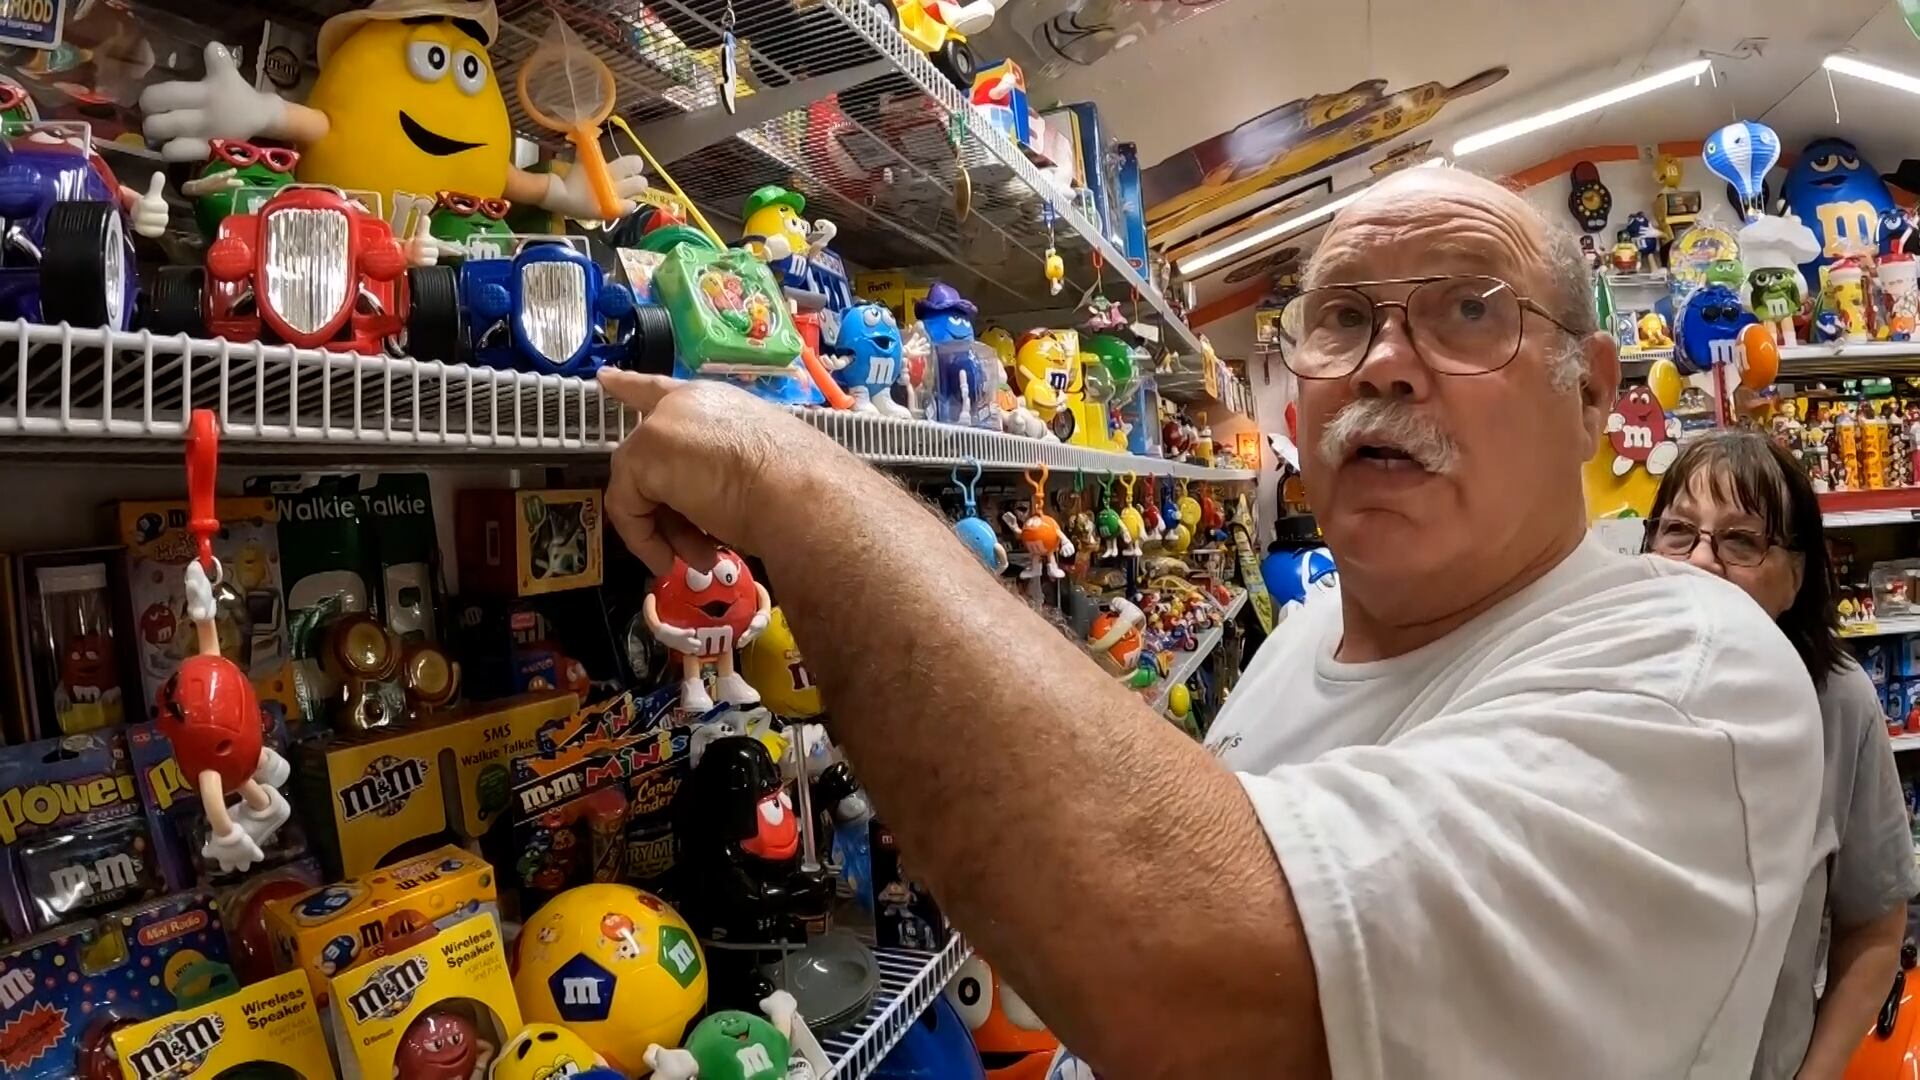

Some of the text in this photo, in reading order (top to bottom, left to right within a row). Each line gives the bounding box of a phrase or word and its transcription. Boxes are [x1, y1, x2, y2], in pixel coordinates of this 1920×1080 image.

[1815, 199, 1880, 258] m
[1765, 298, 1790, 316] m
[865, 355, 895, 385] m
[1623, 424, 1653, 449] m
[360, 493, 426, 517] Talkie
[697, 624, 734, 657] m
[483, 723, 512, 743] SMS
[460, 738, 536, 767] Walkie Talkie
[637, 775, 683, 802] Candy
[170, 915, 201, 932] Radio
[440, 928, 493, 957] Wireless
[446, 940, 496, 969] Speaker
[667, 938, 696, 975] m
[240, 987, 305, 1017] Wireless
[562, 976, 602, 1005] m
[246, 999, 308, 1031] Speaker
[735, 1042, 774, 1079] m
